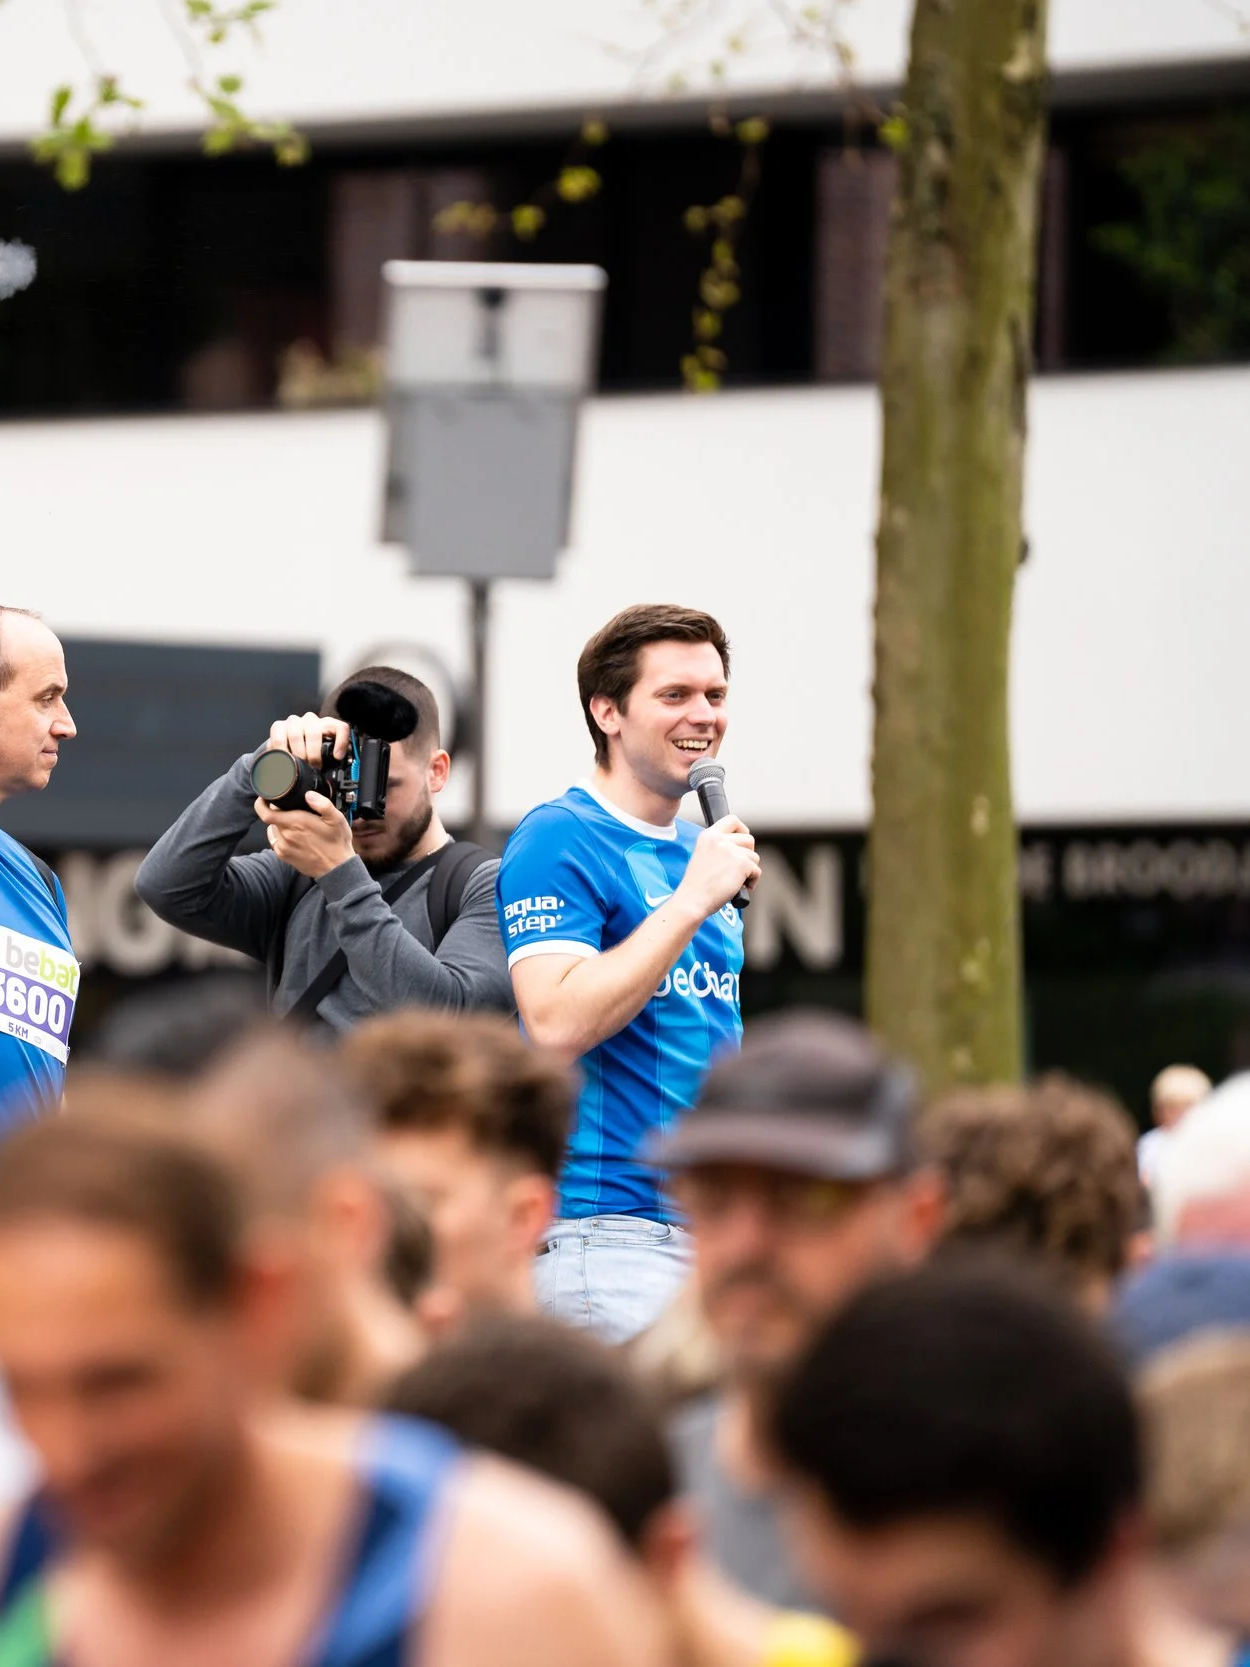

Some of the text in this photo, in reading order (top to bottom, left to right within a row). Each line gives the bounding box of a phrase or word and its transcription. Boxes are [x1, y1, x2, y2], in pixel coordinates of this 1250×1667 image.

[504, 896, 558, 920] aqua
[508, 915, 556, 938] step
[5, 935, 78, 996] bebat
